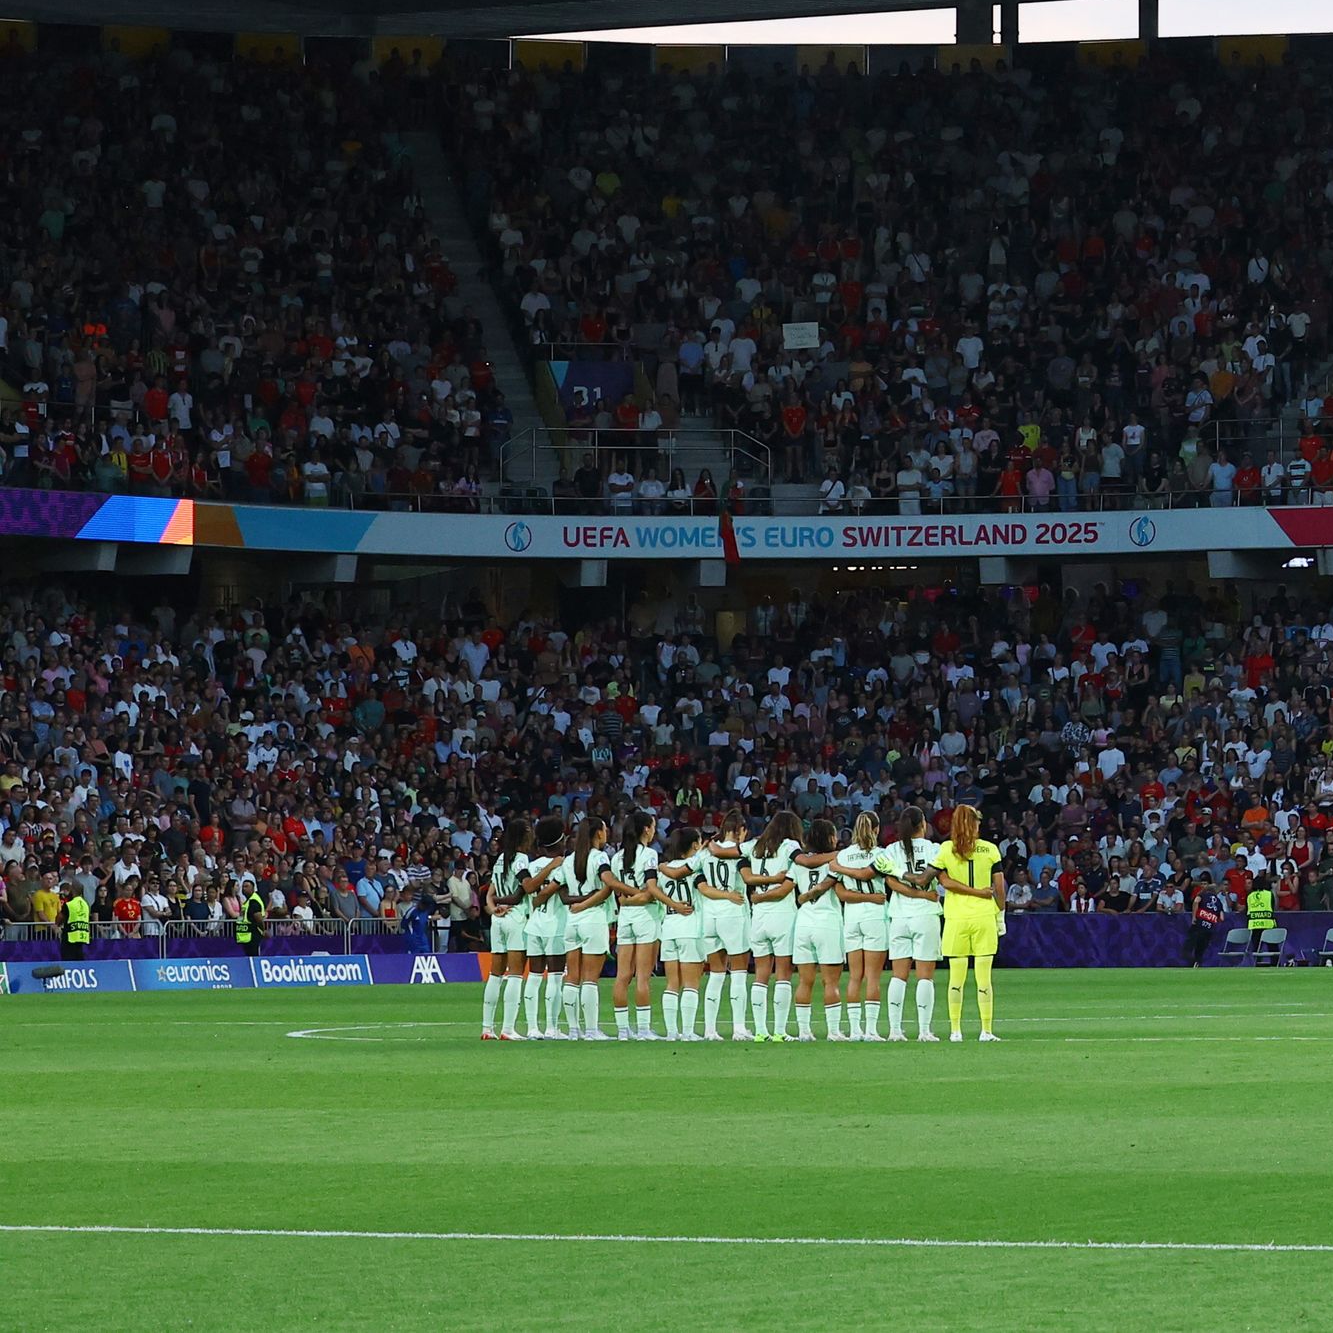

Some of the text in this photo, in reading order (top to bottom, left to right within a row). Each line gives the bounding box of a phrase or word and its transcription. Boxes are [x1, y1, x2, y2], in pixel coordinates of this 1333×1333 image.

[563, 527, 631, 548] UEFA
[635, 526, 756, 548] WOME'S
[764, 526, 834, 548] EURO
[842, 524, 1027, 547] SWITZERLAND
[808, 870, 820, 906] 8
[905, 859, 929, 892] 15
[968, 859, 974, 889] 1
[665, 878, 693, 916] 20
[166, 961, 231, 983] euronics
[261, 959, 363, 986] Booking.com
[409, 955, 447, 984] AXA
